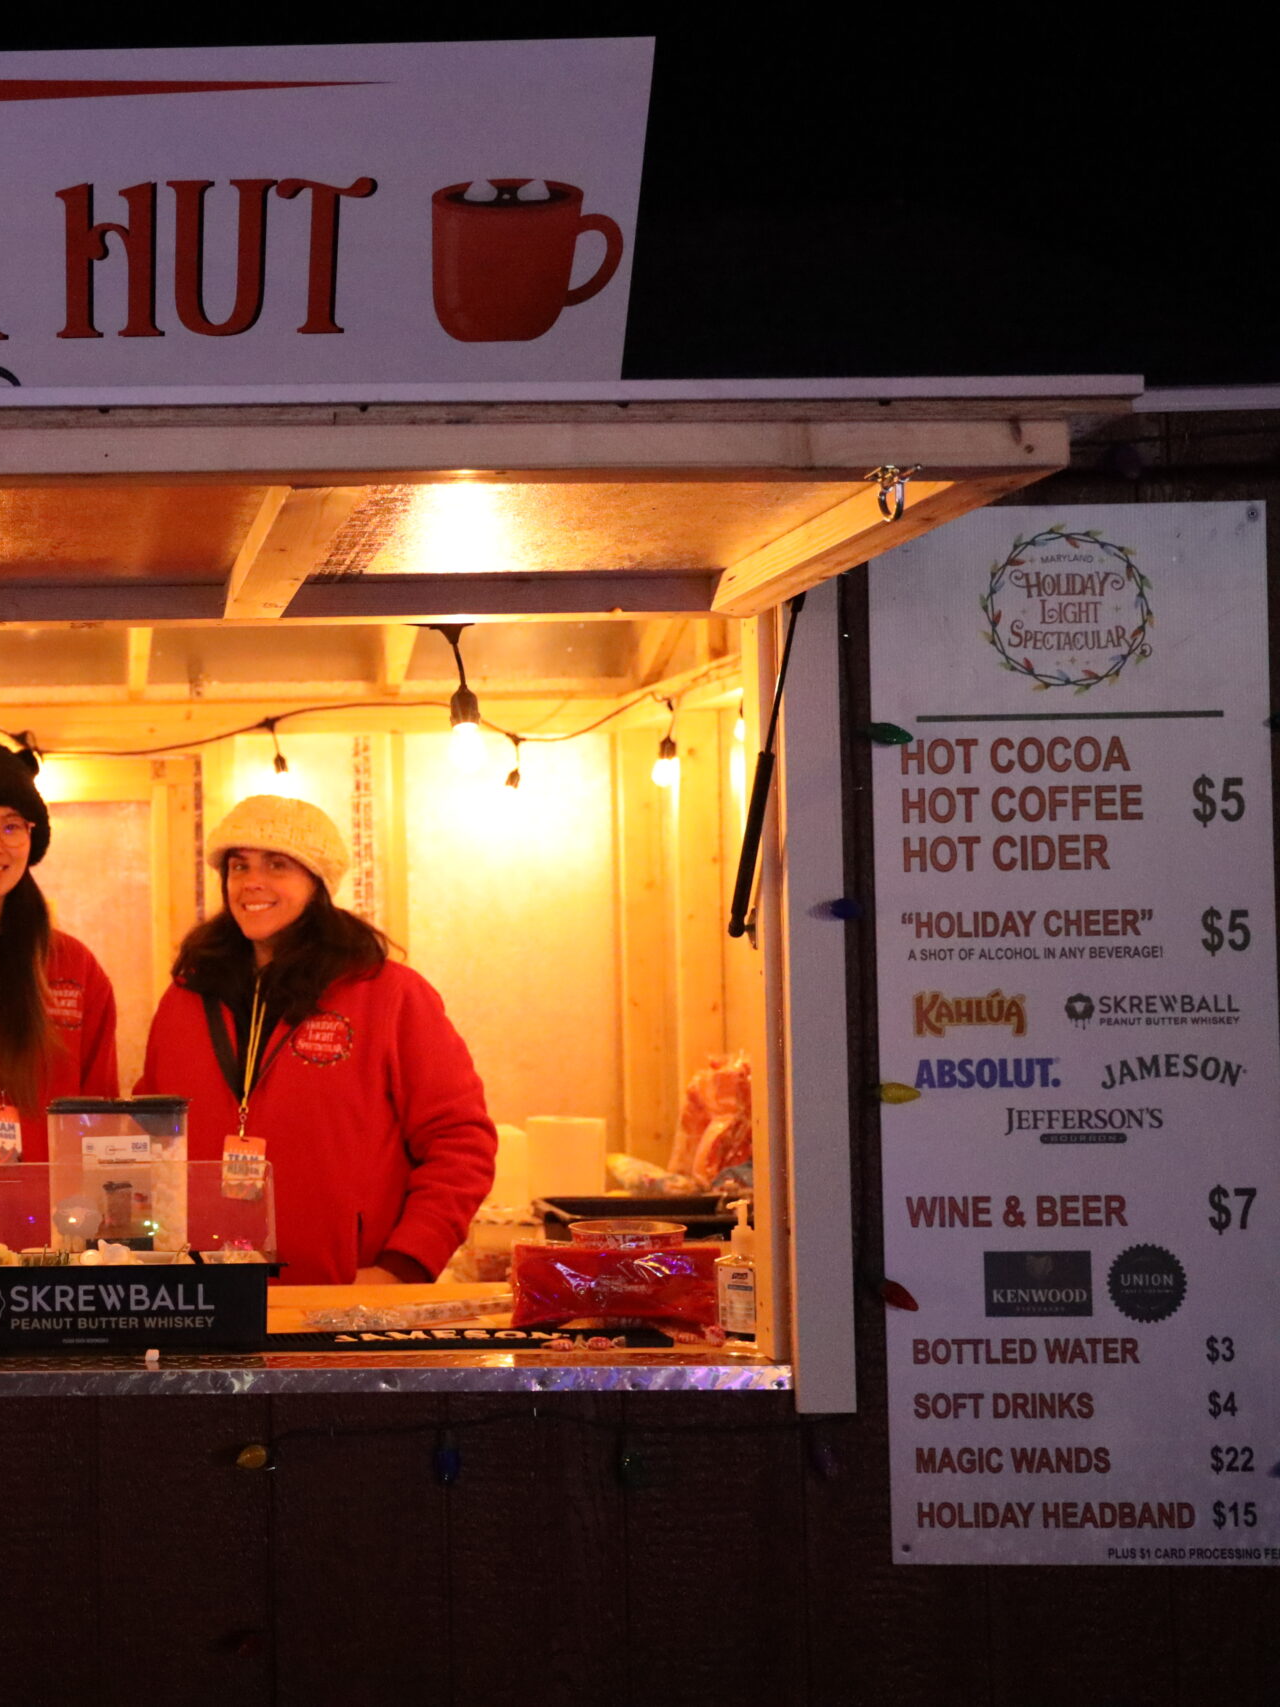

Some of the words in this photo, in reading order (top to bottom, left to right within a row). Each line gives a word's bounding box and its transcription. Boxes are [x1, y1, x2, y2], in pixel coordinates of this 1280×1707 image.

[56, 175, 378, 340] HUT
[1040, 554, 1094, 564] MARYLAND
[1009, 569, 1125, 598] HOLIDAY
[1040, 600, 1102, 625] LIGHT
[1008, 620, 1152, 658] SPECTACULAR
[900, 738, 978, 775] HOT
[990, 736, 1130, 773] COCOA
[902, 787, 979, 823] HOT
[991, 784, 1144, 822] COFFEE
[1192, 774, 1245, 827] $5
[903, 836, 980, 872] HOT
[992, 834, 1110, 871] CIDER
[1201, 906, 1250, 956] $5
[908, 949, 918, 960] A
[920, 948, 955, 961] SHOT
[958, 948, 975, 960] OF
[978, 947, 1040, 960] ALCOHOL
[1044, 947, 1056, 959] IN
[1059, 947, 1086, 959] ANY
[1089, 946, 1164, 959] BEVERAGE!
[1099, 994, 1240, 1014] SKREWBALL
[1099, 1017, 1141, 1026] PEANUT
[1145, 1016, 1188, 1025] BUTTER
[1191, 1016, 1240, 1025] WHISKEY
[1101, 1053, 1242, 1089] JAMESON
[1005, 1107, 1163, 1135] JEFFERSON'S
[1050, 1134, 1116, 1143] BOURBON
[228, 1154, 259, 1162] TEAM
[906, 1196, 993, 1227] WINE
[1002, 1196, 1026, 1227] &
[1036, 1194, 1128, 1226] BEER
[1208, 1185, 1256, 1234] $7
[1121, 1273, 1173, 1286] UNION
[10, 1283, 215, 1312] SKREWBALL
[992, 1287, 1087, 1303] KENWOOD
[10, 1318, 74, 1330] PEANUT
[78, 1317, 140, 1329] BUTTER
[143, 1316, 215, 1328] WHISKEY
[334, 1329, 561, 1342] JAMESON
[912, 1339, 1036, 1364] BOTTLED
[1045, 1337, 1140, 1364] WATER
[1206, 1336, 1235, 1364] $3
[913, 1393, 984, 1419] SOFT
[993, 1392, 1094, 1418] DRINKS
[1208, 1391, 1237, 1418] $4
[916, 1447, 1003, 1474] MAGIC
[1011, 1446, 1111, 1473] WANDS
[1210, 1445, 1254, 1474] $22
[918, 1502, 1035, 1528] HOLIDAY
[1042, 1501, 1195, 1528] HEADBAND
[1212, 1501, 1257, 1530] $15
[1108, 1548, 1136, 1559] PLUS
[1139, 1548, 1151, 1559] $1
[1154, 1548, 1185, 1559] CARD
[1189, 1548, 1261, 1559] PROCESSING
